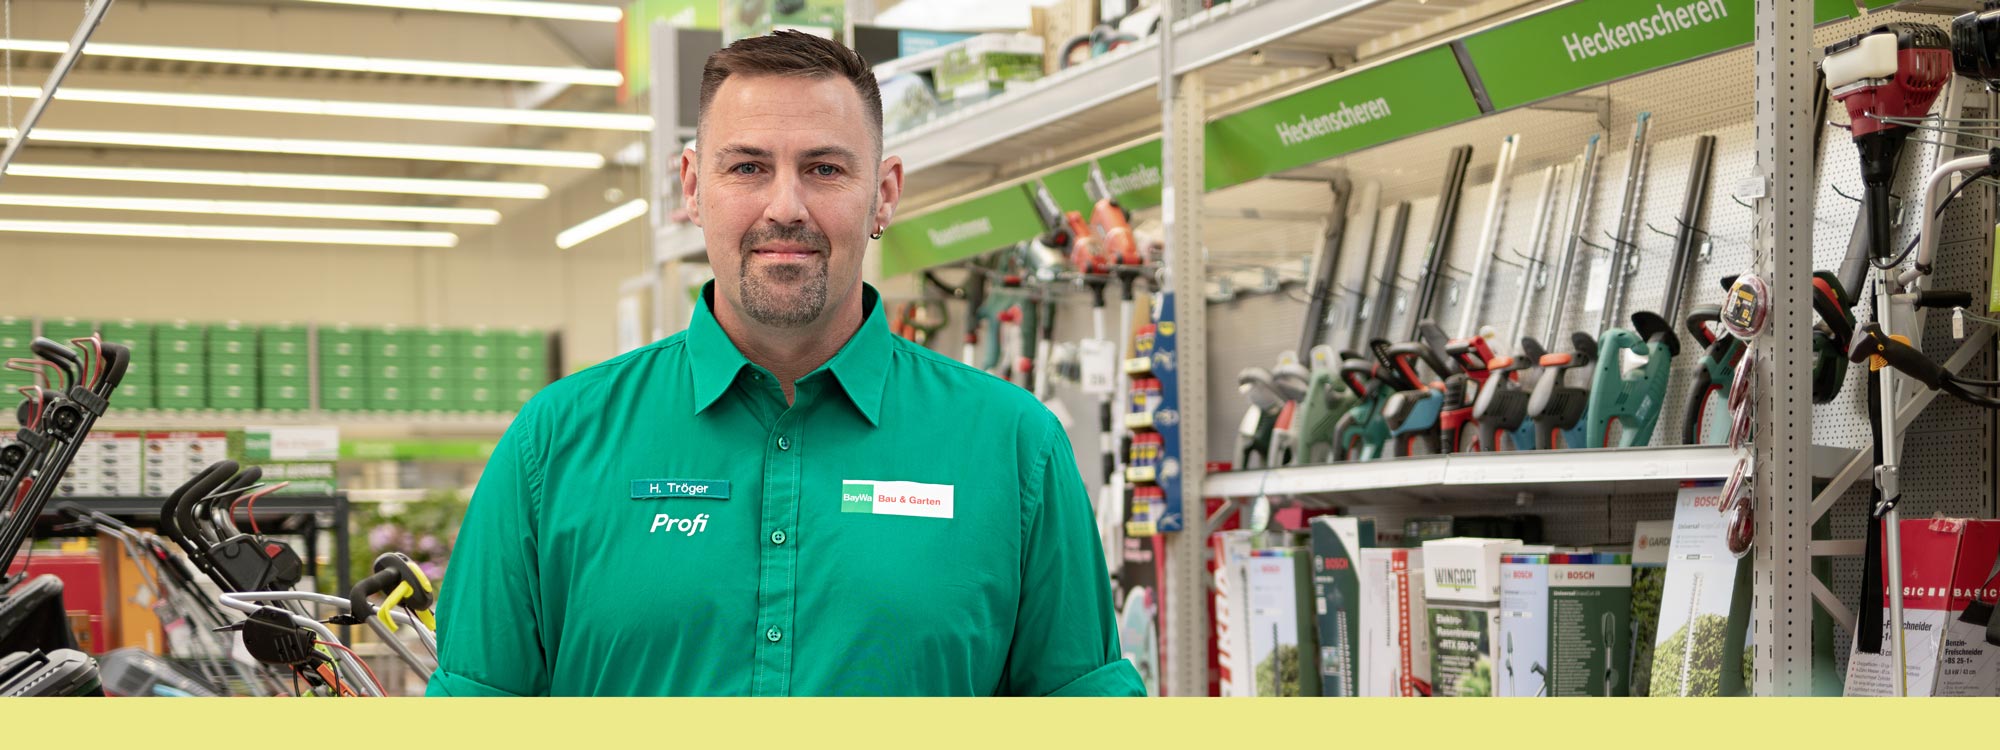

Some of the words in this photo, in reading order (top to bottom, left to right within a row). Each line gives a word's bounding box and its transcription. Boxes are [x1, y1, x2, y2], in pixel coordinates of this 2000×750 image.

[1562, 0, 1728, 62] Heckenscheren
[1276, 96, 1391, 147] Heckenscheren
[650, 483, 661, 493] H.
[667, 482, 709, 496] Tröger
[843, 493, 873, 503] BayWa
[878, 494, 897, 503] Bau
[899, 495, 906, 504] &
[909, 496, 941, 506] Garten
[650, 513, 710, 537] Profi
[1649, 536, 1671, 547] GARD
[1435, 567, 1477, 590] WINGART
[1512, 570, 1533, 580] BOSCH
[1567, 571, 1595, 580] BOSCH
[1953, 588, 1998, 598] BASIC
[1945, 639, 1968, 647] Benzin-
[1945, 648, 1984, 656] Freischneider
